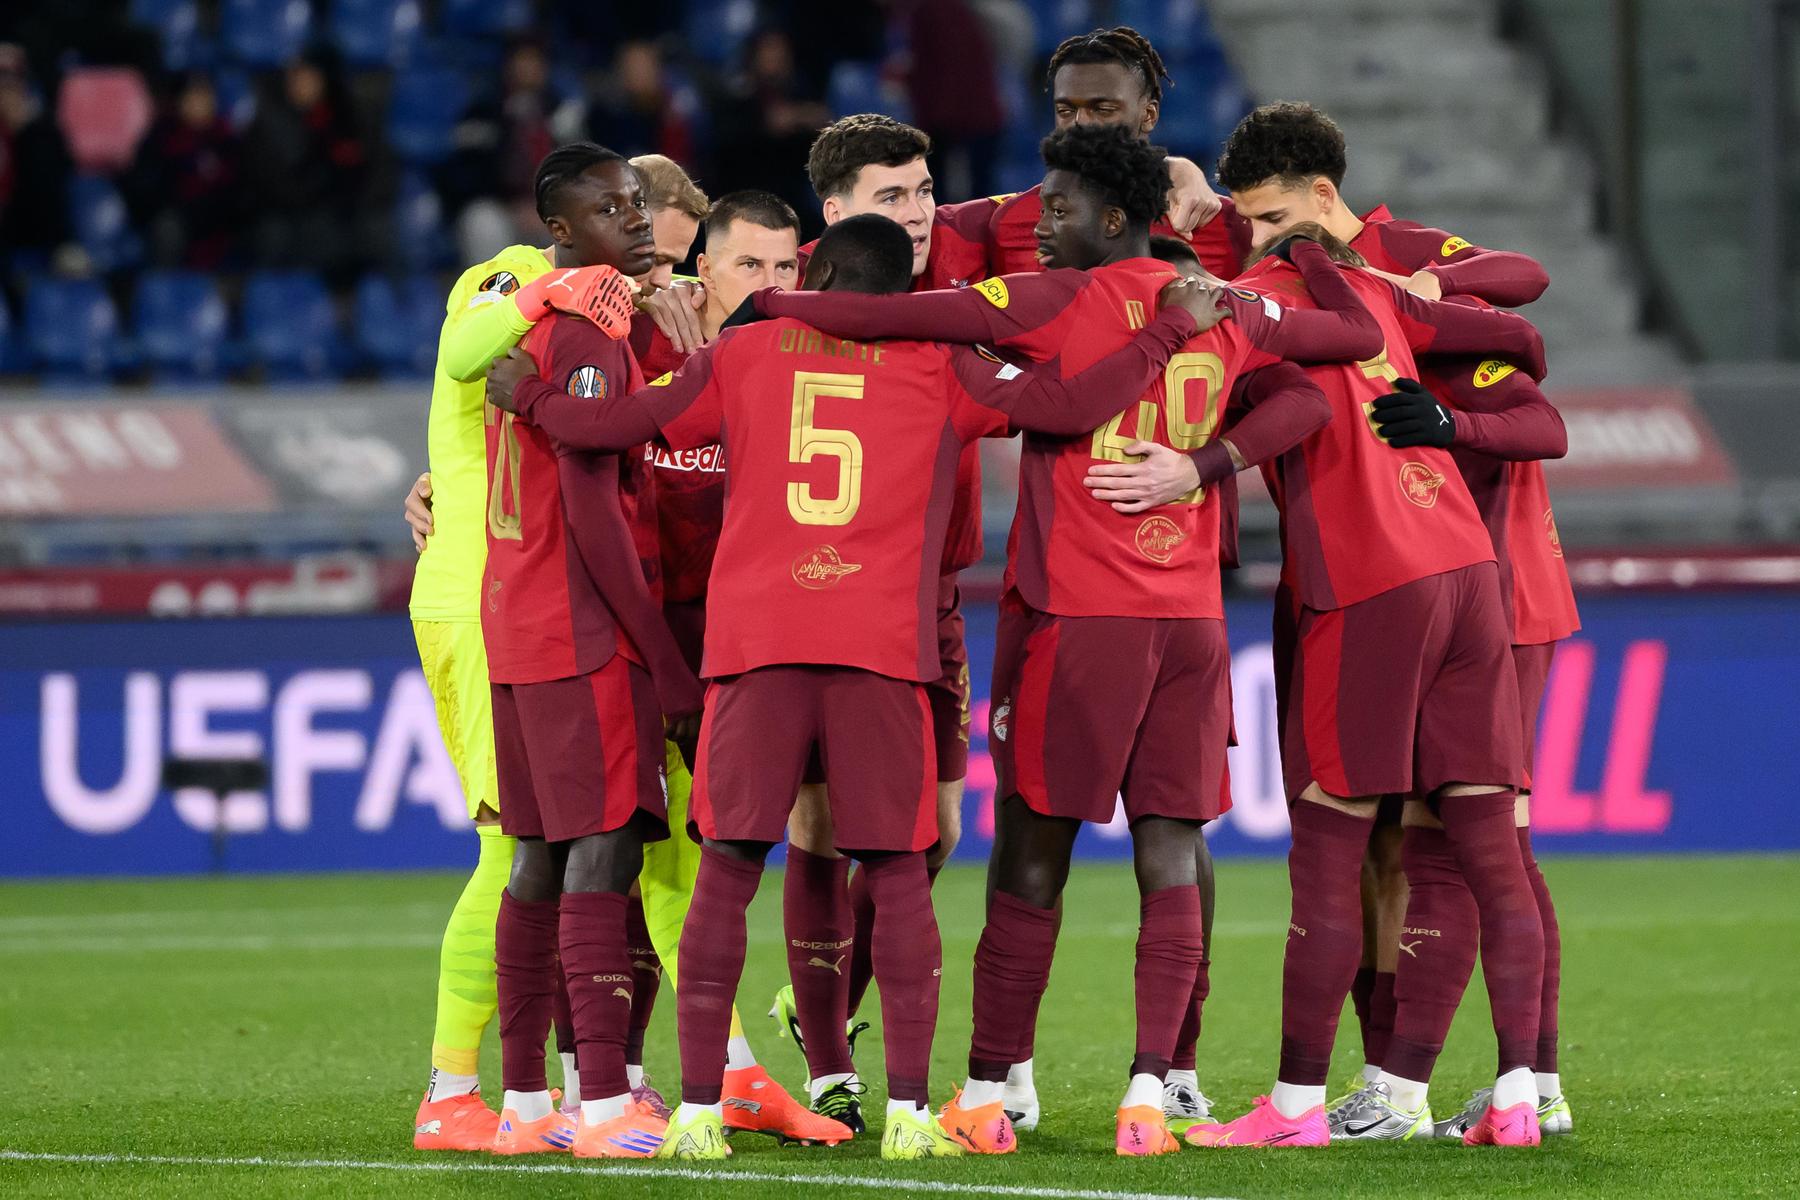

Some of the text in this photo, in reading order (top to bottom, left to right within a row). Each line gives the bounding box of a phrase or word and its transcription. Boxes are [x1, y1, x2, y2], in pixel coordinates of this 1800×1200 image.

[787, 371, 865, 526] 5
[40, 670, 474, 834] UEFA
[1530, 636, 1674, 834] LL
